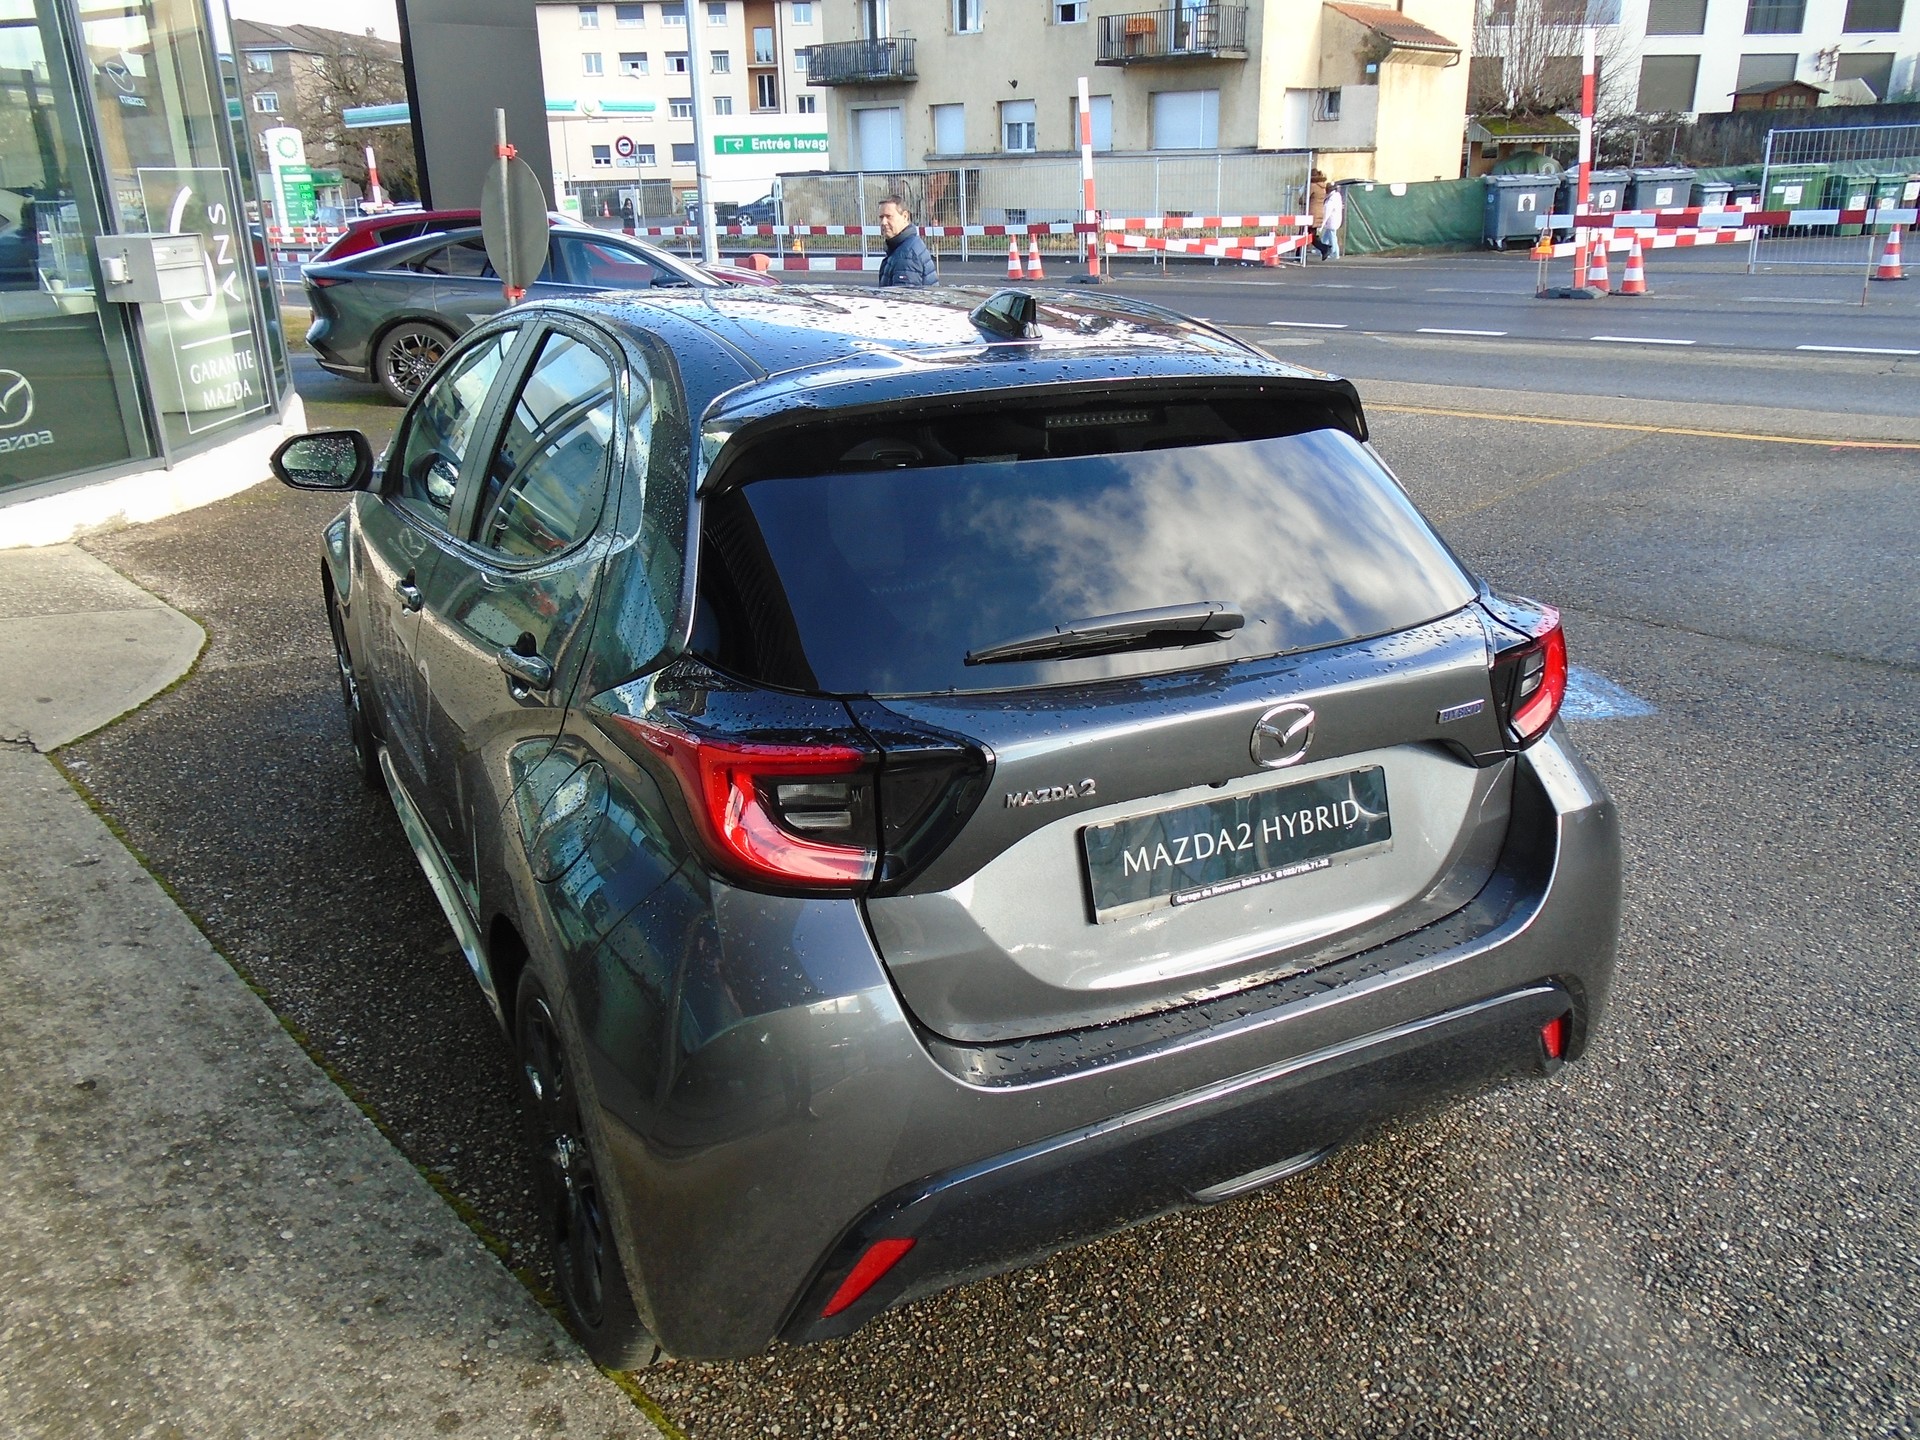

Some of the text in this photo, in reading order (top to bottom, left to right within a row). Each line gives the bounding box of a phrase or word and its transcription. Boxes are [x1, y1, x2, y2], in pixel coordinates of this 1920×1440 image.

[751, 136, 829, 151] Entrée lavag
[208, 203, 241, 302] ANS
[190, 349, 254, 385] GARANTIE
[203, 379, 253, 411] MAZDA
[0, 430, 55, 454] azda
[1123, 799, 1360, 877] MAZDA2 HYBRID
